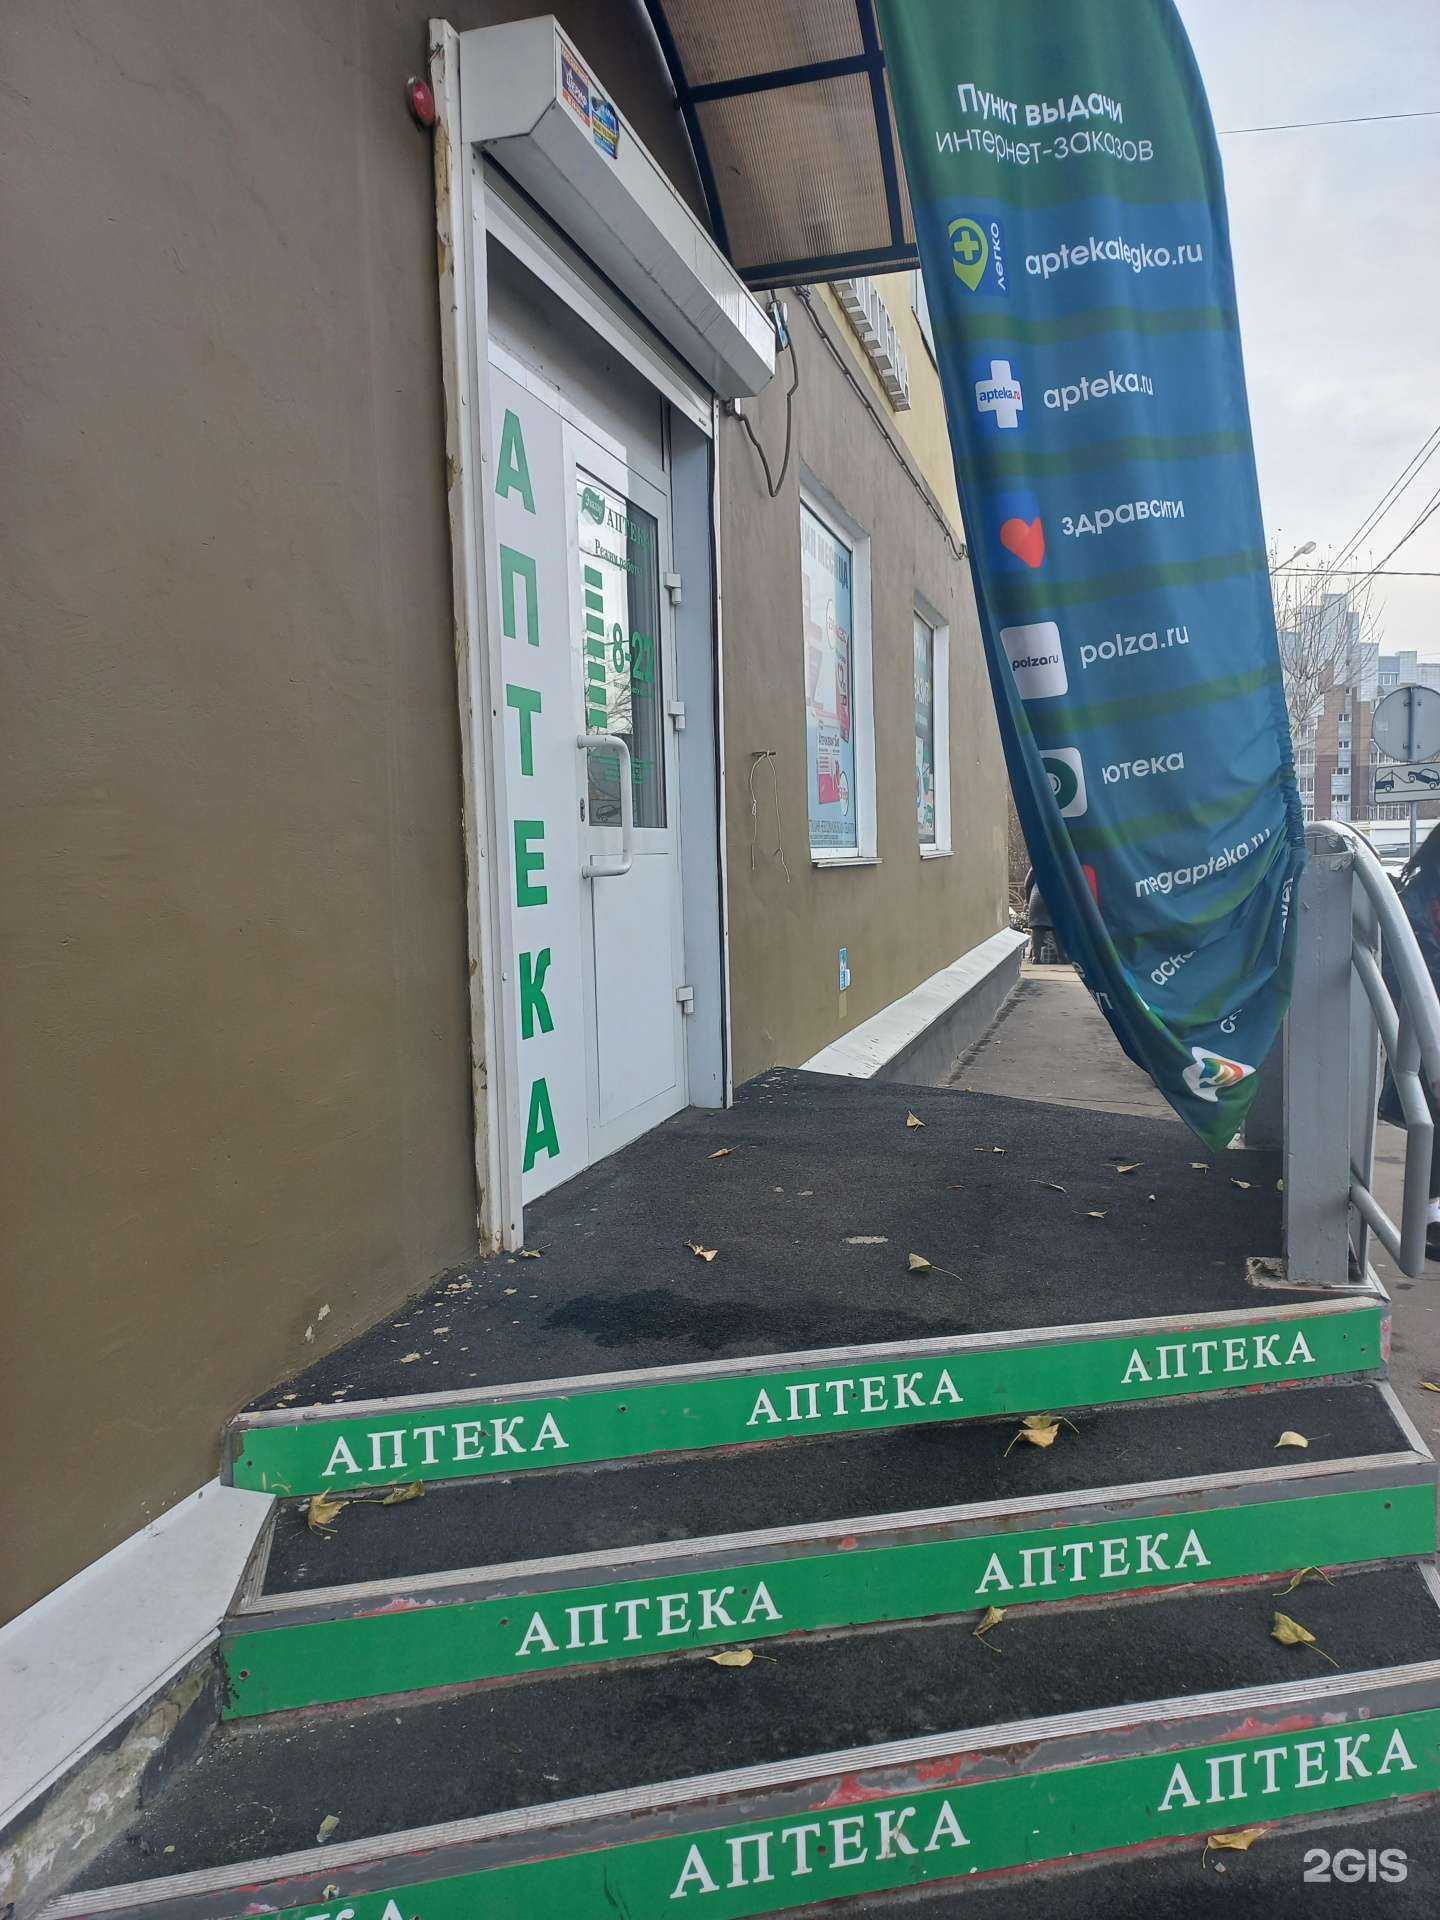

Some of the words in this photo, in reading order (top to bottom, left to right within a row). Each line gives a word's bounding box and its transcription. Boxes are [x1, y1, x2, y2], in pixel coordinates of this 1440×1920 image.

[957, 83, 1017, 124] Пункт
[1025, 92, 1123, 126] выдачи
[935, 129, 1154, 165] интернет-заказов
[1025, 236, 1203, 279] aptekalegko.ru
[1043, 370, 1154, 411] apteka.ru
[1062, 499, 1185, 538] здравсити
[1080, 626, 1189, 669] polza.ru
[1102, 752, 1184, 784] ютека
[321, 1411, 569, 1476] АПТЕКА
[746, 1367, 964, 1426] АПТЕКА
[1120, 1329, 1316, 1384] АПТЕКА
[515, 1581, 783, 1656] АПТЕКА
[974, 1528, 1212, 1594] АПТЕКА
[670, 1800, 971, 1899] АПТЕКА
[1157, 1727, 1418, 1812] АПТЕКА
